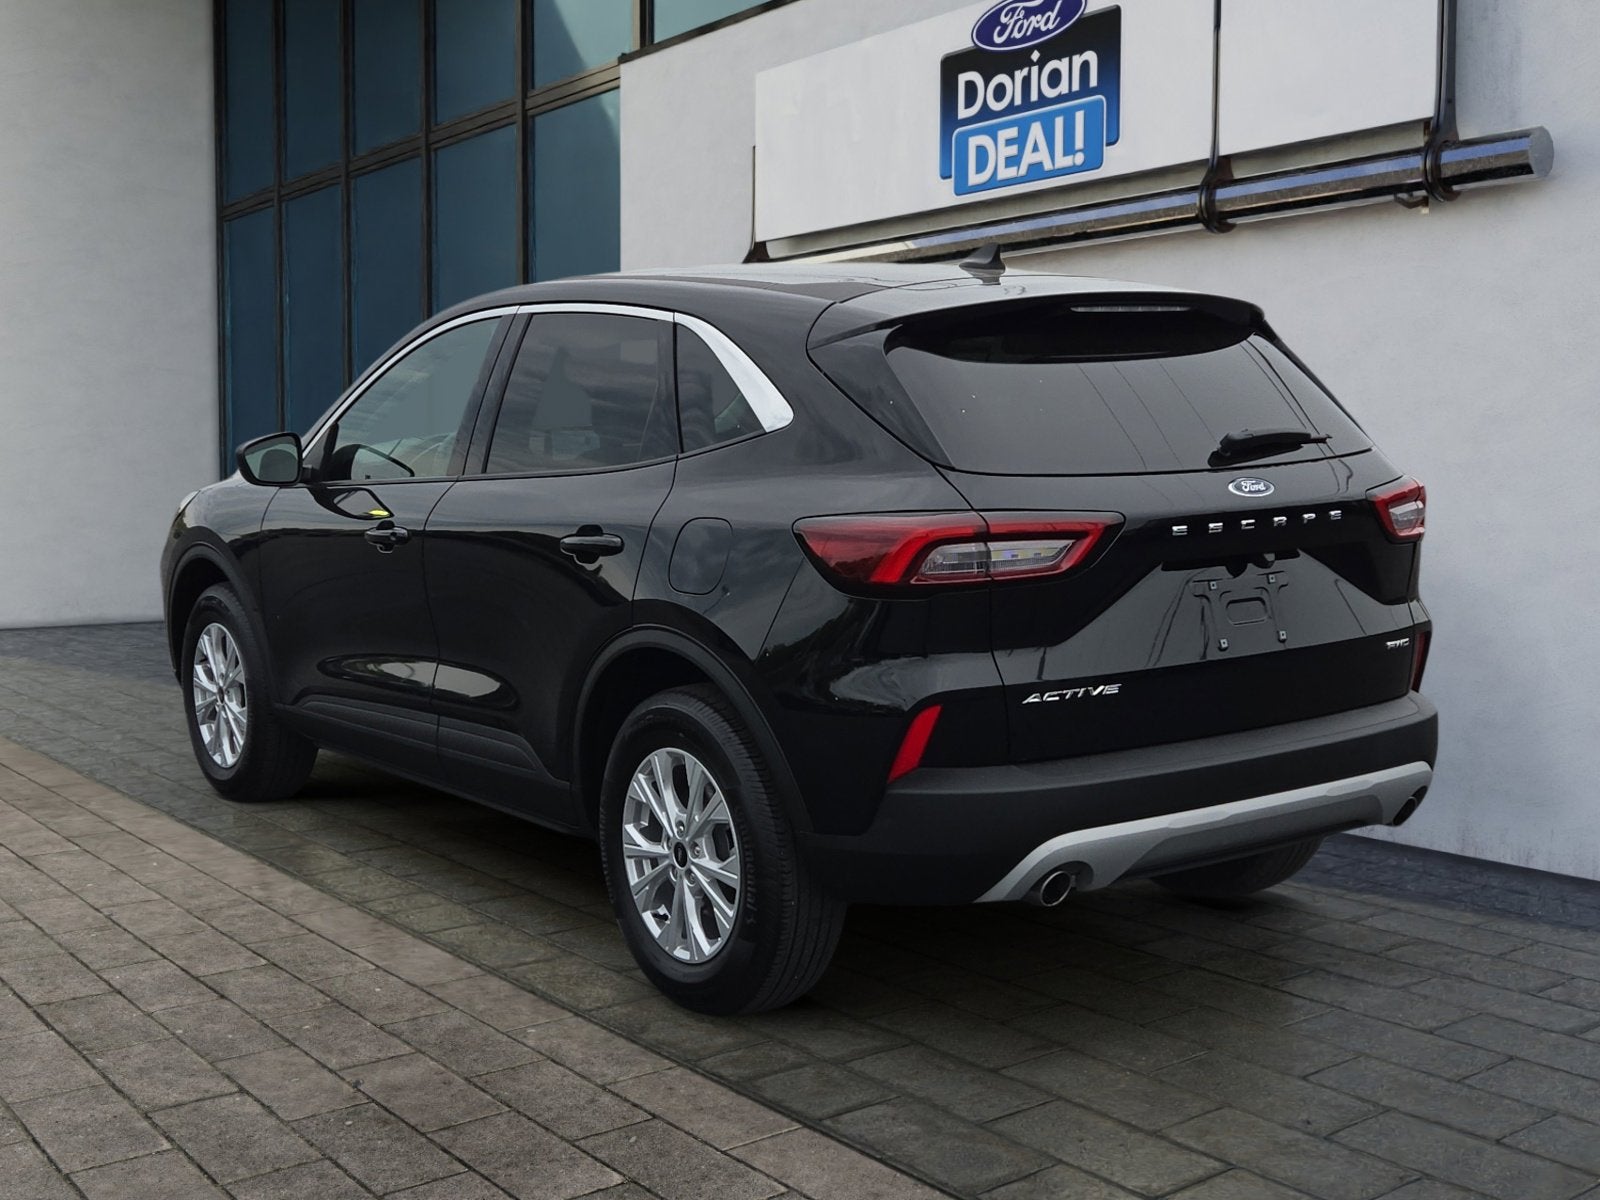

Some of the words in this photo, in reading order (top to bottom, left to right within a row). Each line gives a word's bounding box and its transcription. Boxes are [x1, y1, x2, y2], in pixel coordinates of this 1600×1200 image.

[993, 0, 1063, 44] Ford
[957, 50, 1098, 120] Dorian
[967, 110, 1085, 187] DEAL!
[1171, 510, 1342, 536] ESCAPE
[1022, 683, 1123, 705] ACTIVE
